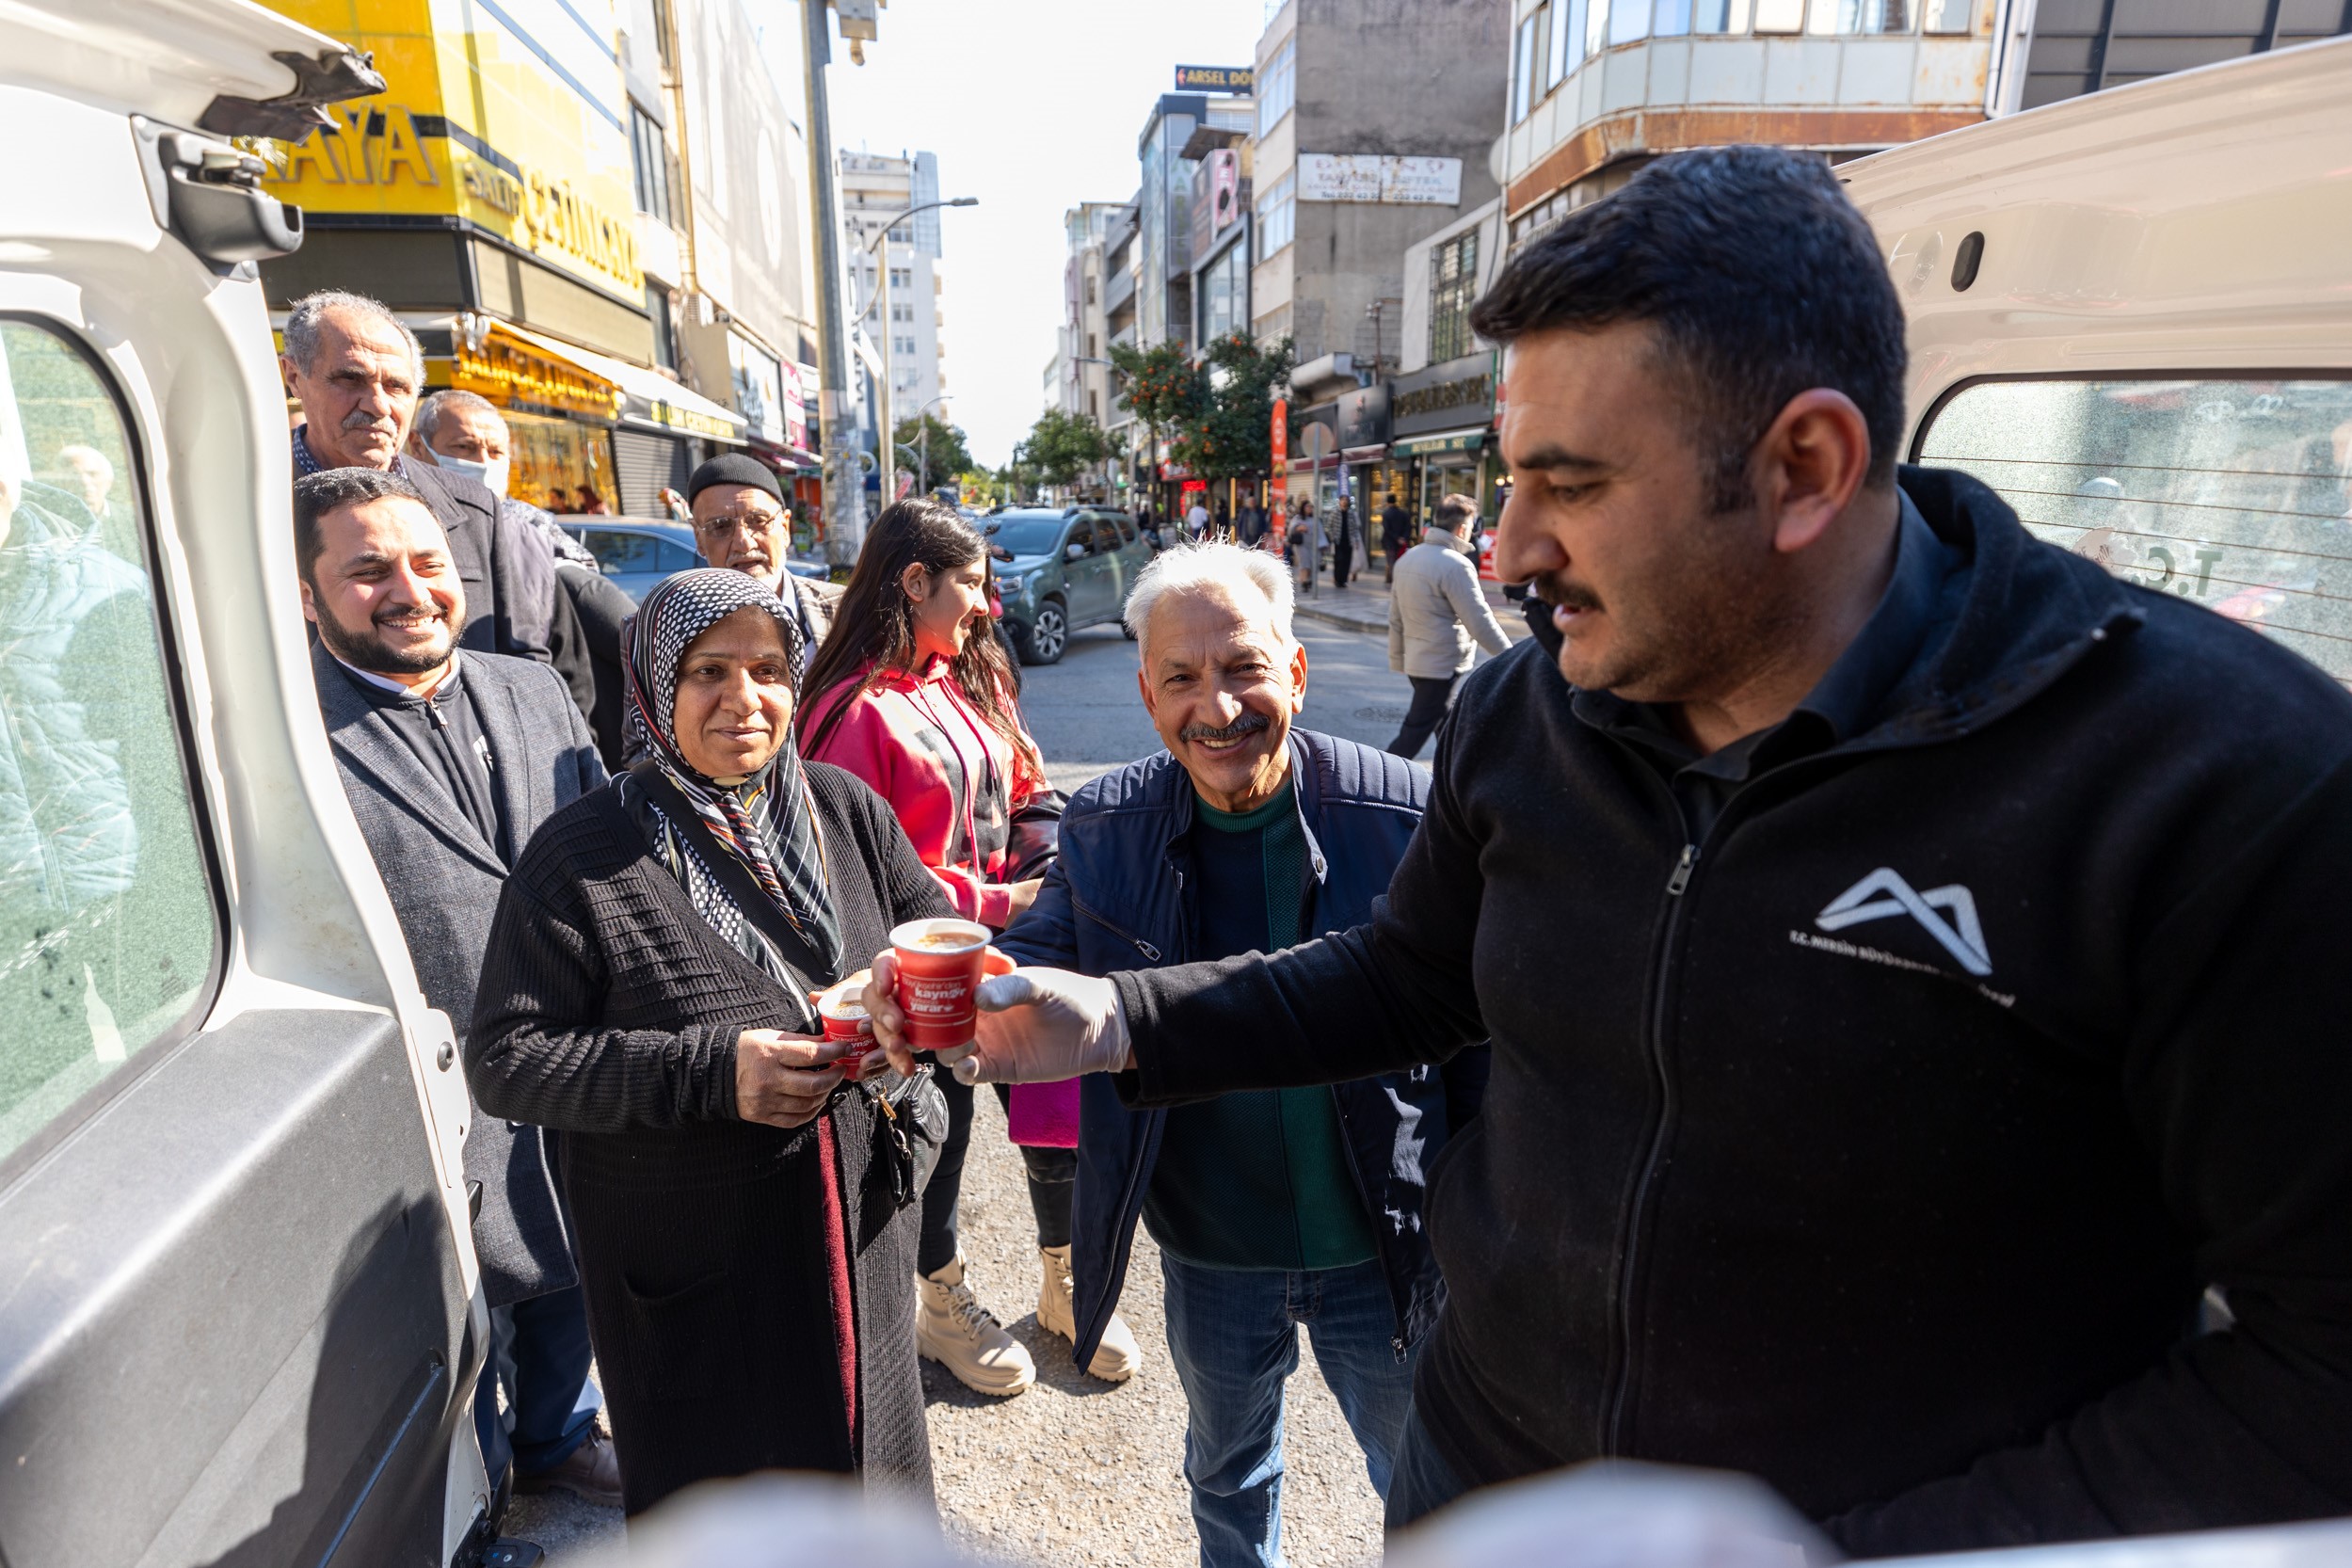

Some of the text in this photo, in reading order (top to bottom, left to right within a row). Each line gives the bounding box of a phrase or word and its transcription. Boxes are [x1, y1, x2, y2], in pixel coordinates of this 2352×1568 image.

[1186, 70, 1253, 86] ARSEL DÖ
[263, 103, 439, 186] AYA
[1811, 935, 1857, 958] MERSİN
[910, 1002, 943, 1013] yarar
[851, 1038, 874, 1048] ynar
